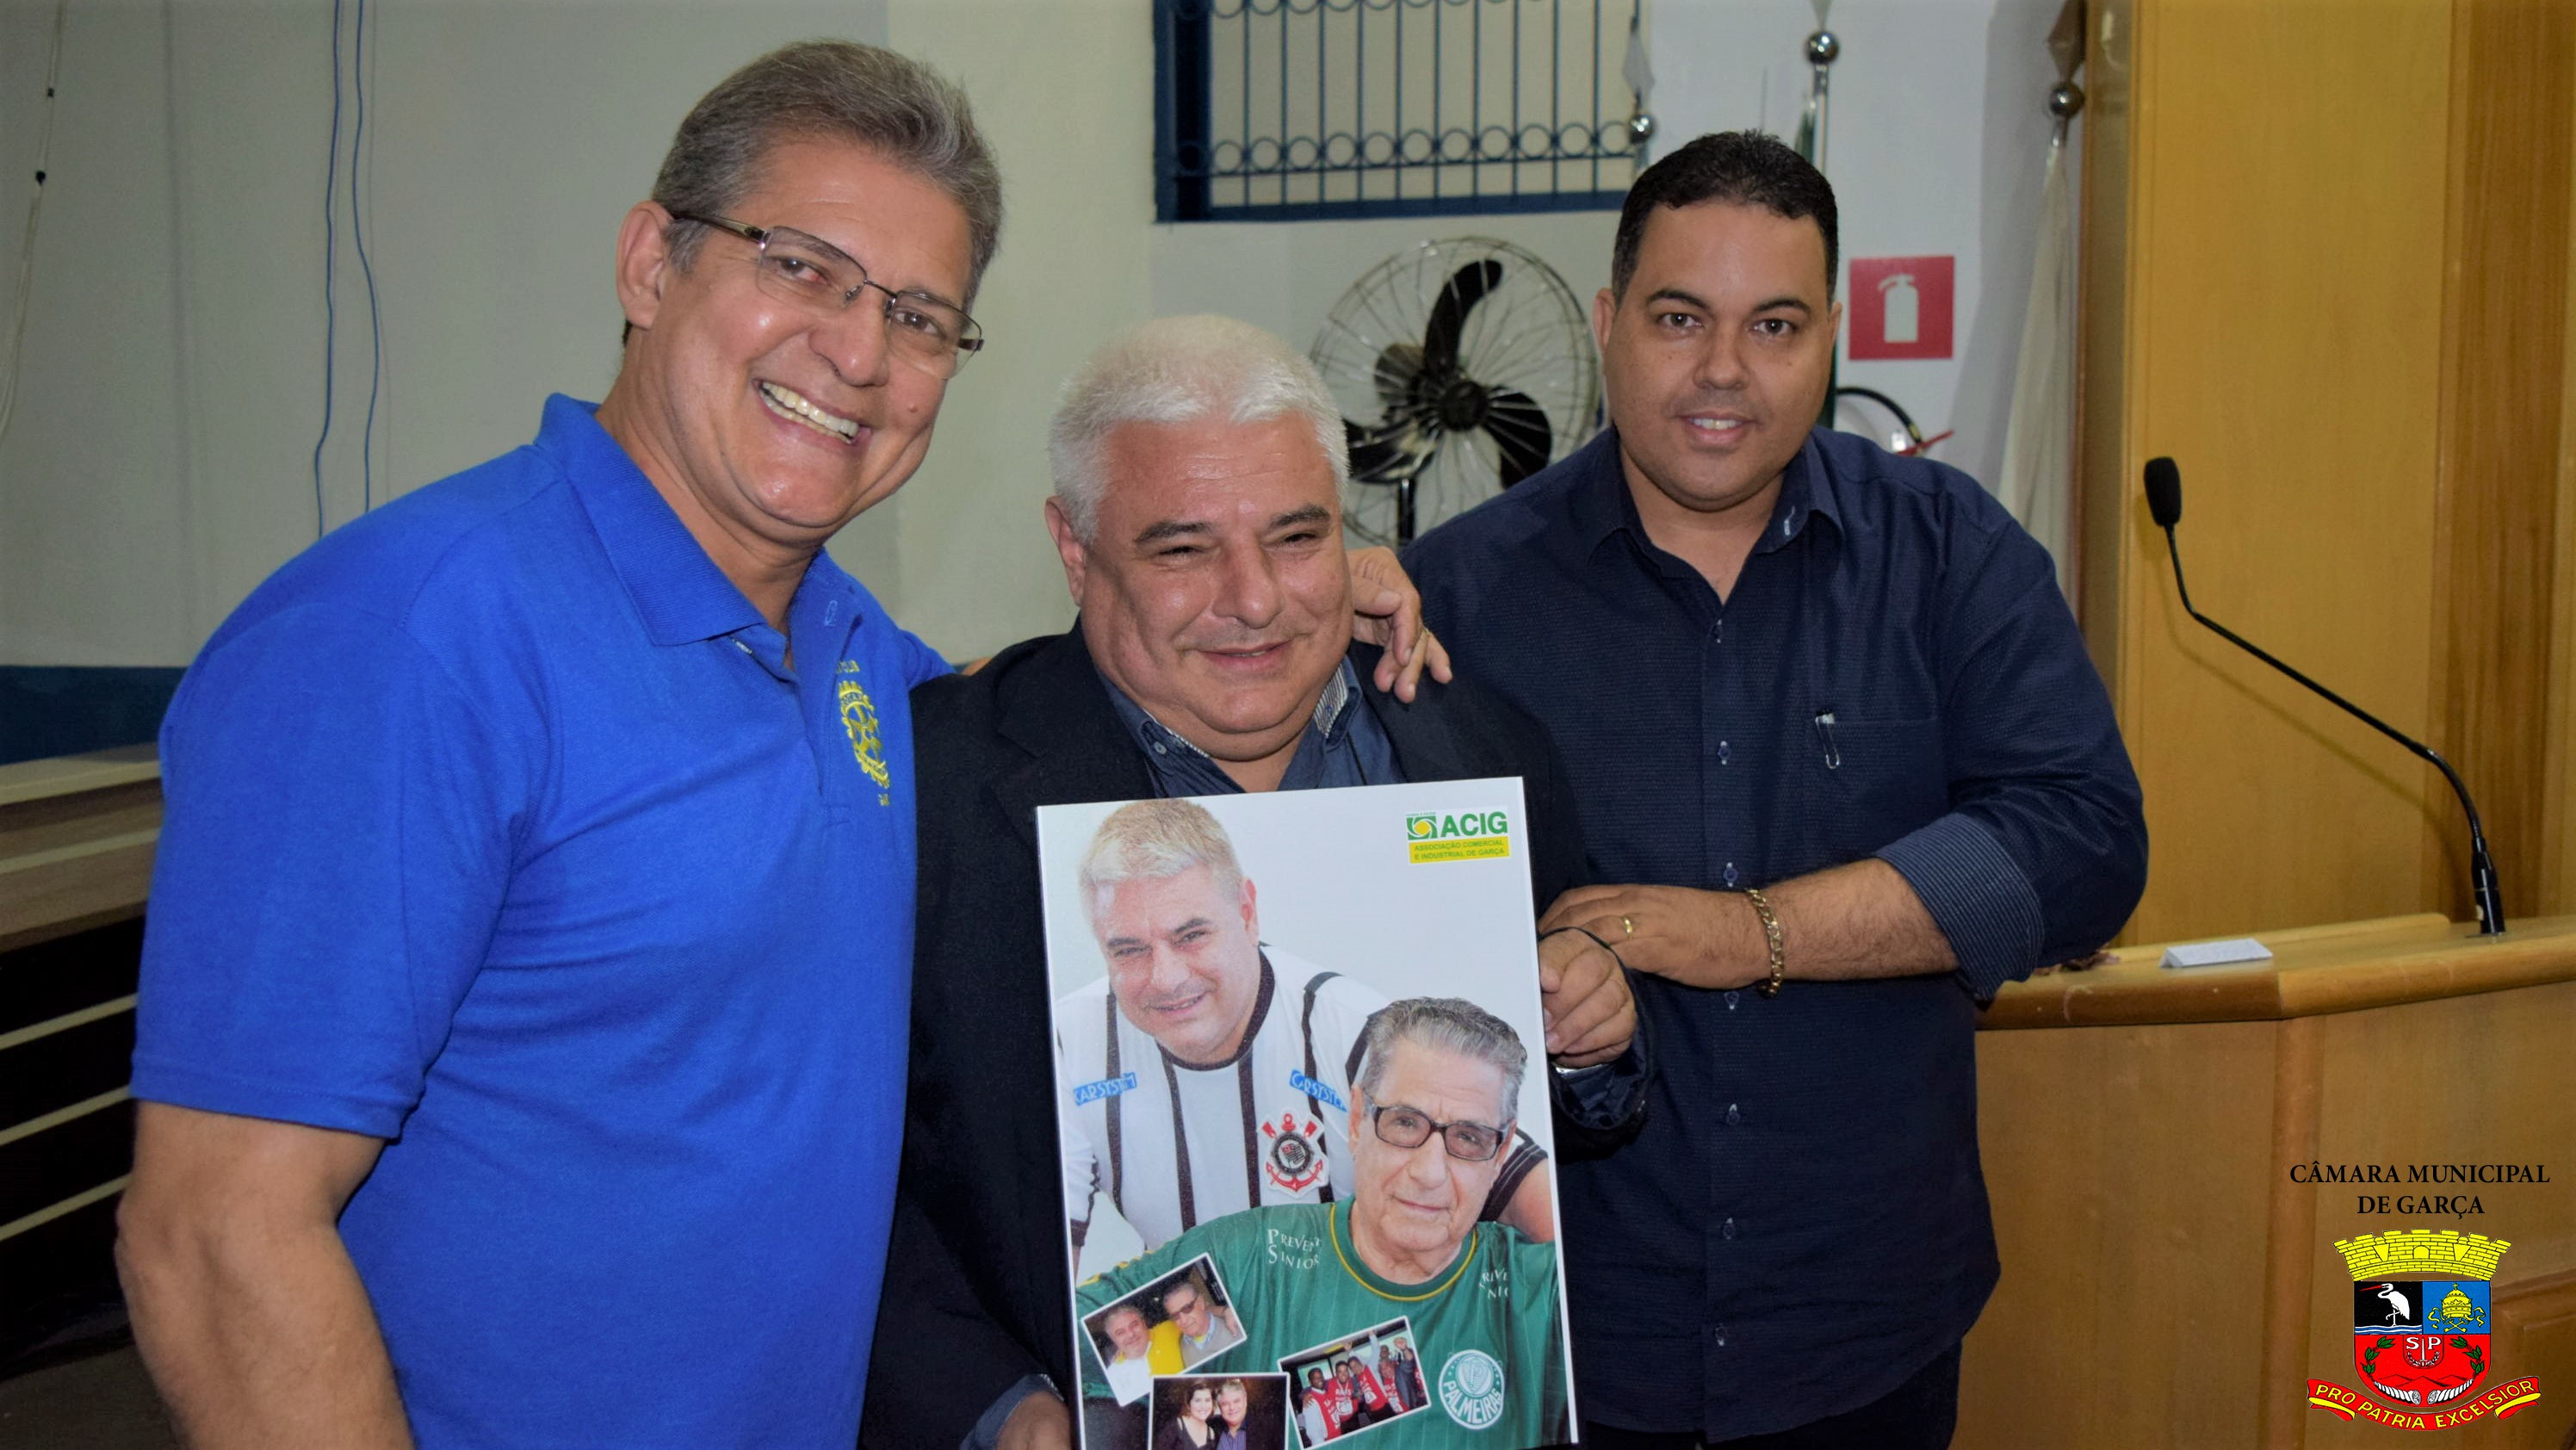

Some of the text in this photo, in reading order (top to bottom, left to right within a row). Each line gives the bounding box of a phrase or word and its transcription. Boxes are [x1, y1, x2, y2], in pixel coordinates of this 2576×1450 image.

[1440, 811, 1508, 838] ACIG
[1415, 840, 1503, 852] ASSOCIAÇÃO COMERCIAL
[1421, 851, 1465, 859] INDUSTRIAL
